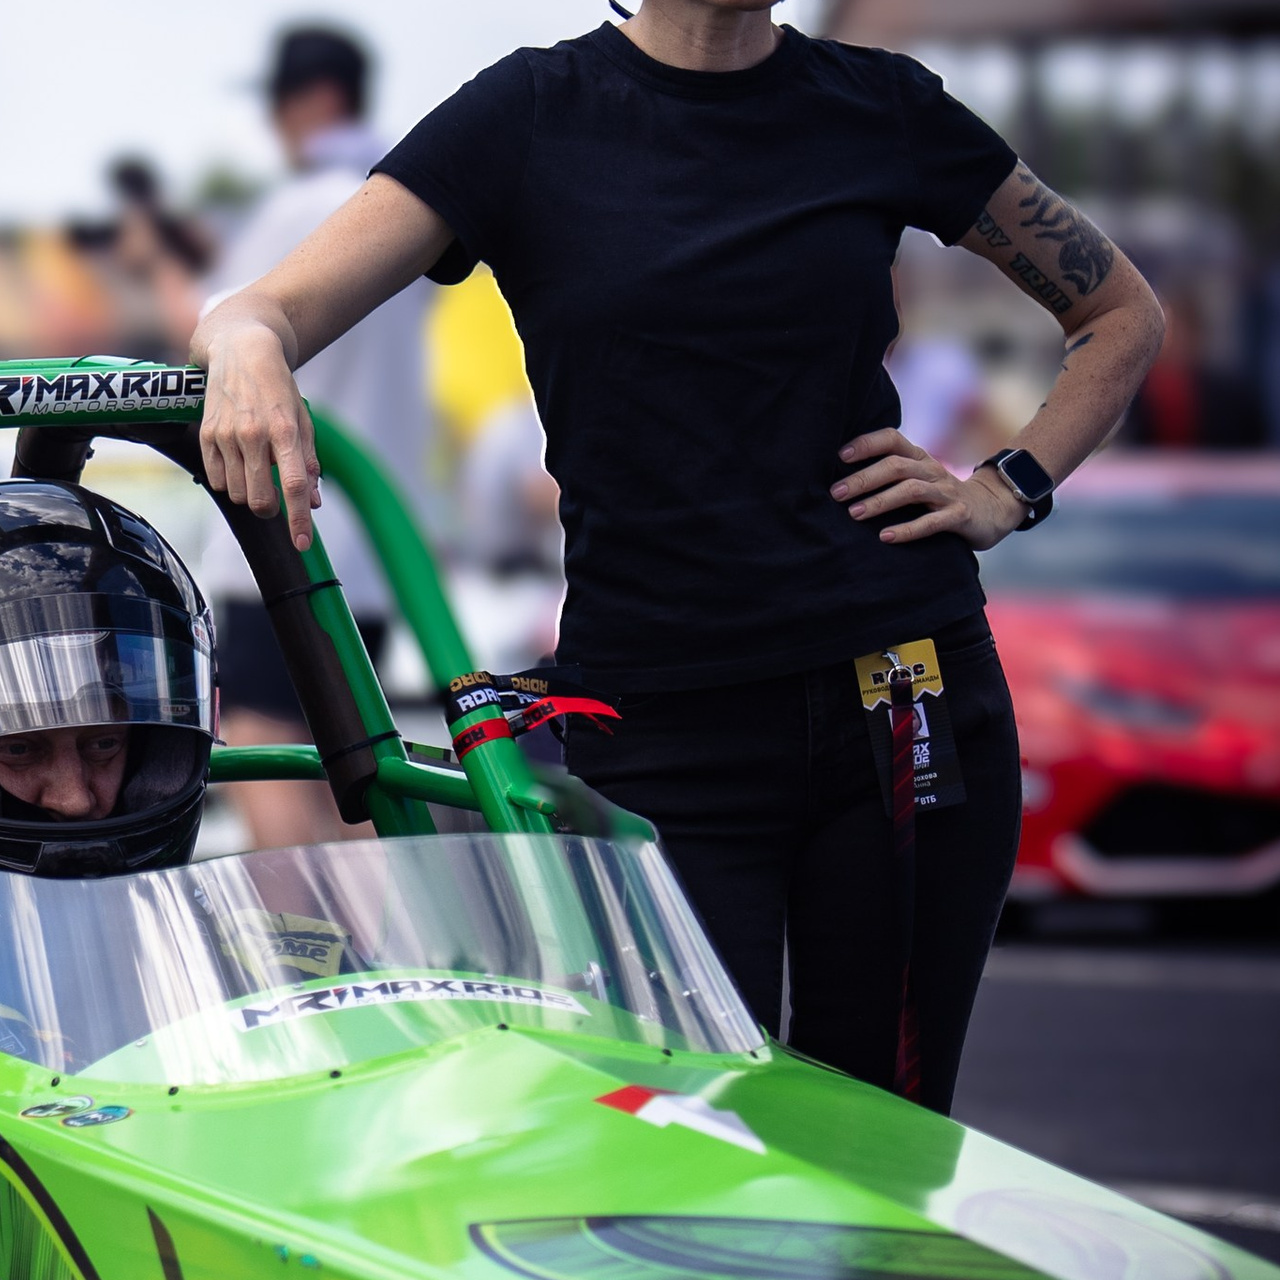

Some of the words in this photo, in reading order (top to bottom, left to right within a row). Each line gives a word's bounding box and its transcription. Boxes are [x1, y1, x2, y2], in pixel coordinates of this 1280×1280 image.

[976, 209, 1012, 248] AY
[31, 396, 205, 415] MOTORSPORT
[510, 676, 549, 695] RDRC
[862, 684, 890, 697] РУКОВОД
[913, 674, 939, 685] ОМАНДЫ
[913, 742, 930, 755] AX
[914, 772, 938, 783] охова
